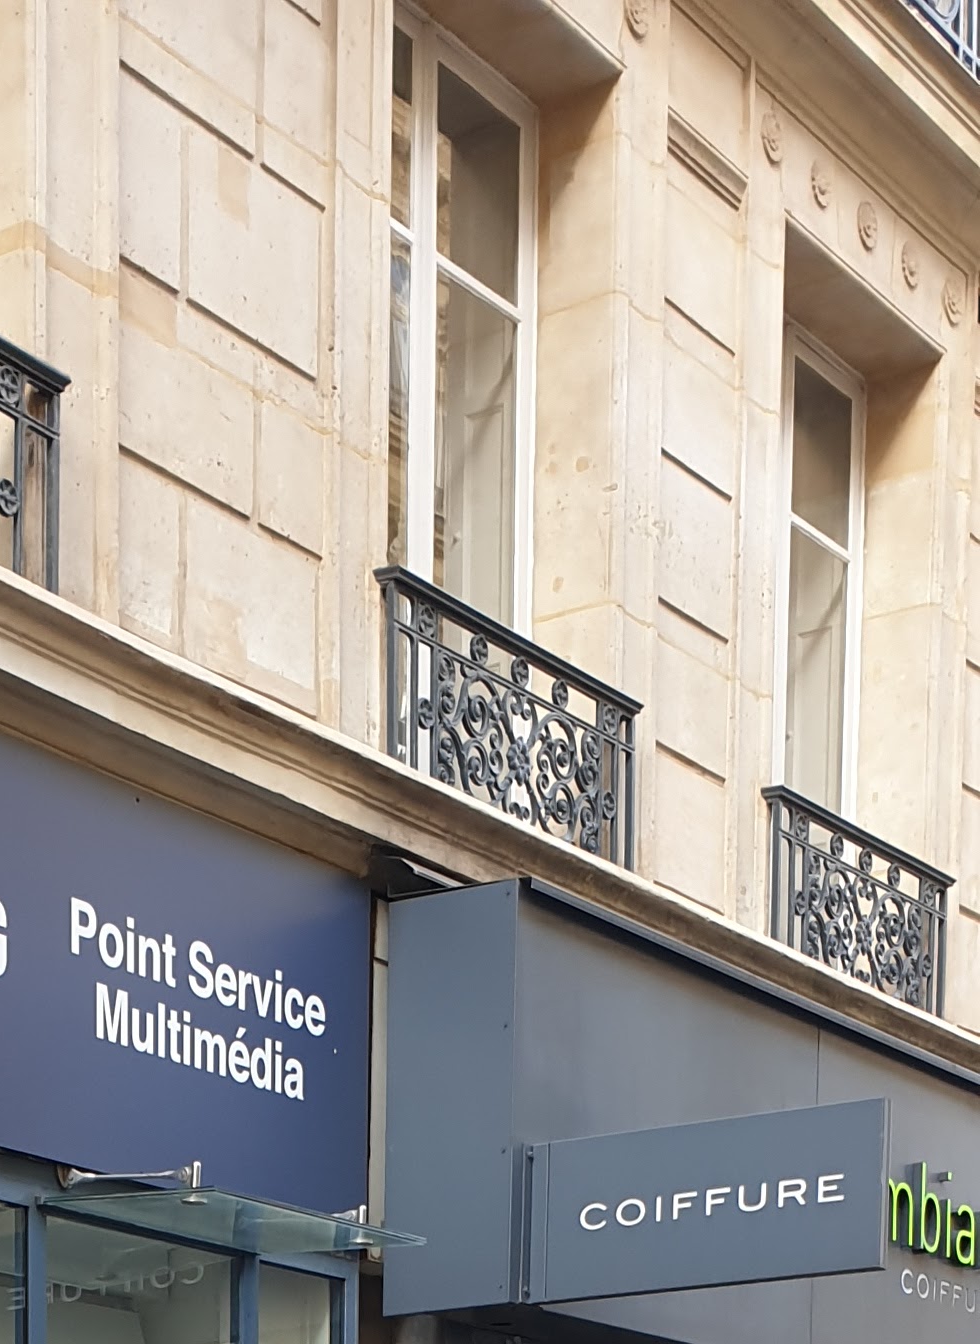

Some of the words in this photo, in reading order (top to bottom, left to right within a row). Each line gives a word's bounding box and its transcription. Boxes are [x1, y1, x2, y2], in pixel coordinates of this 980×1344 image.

[70, 896, 177, 988] Point
[188, 940, 327, 1037] Service
[94, 981, 306, 1101] Multimédia
[578, 1172, 845, 1231] COIFFURE
